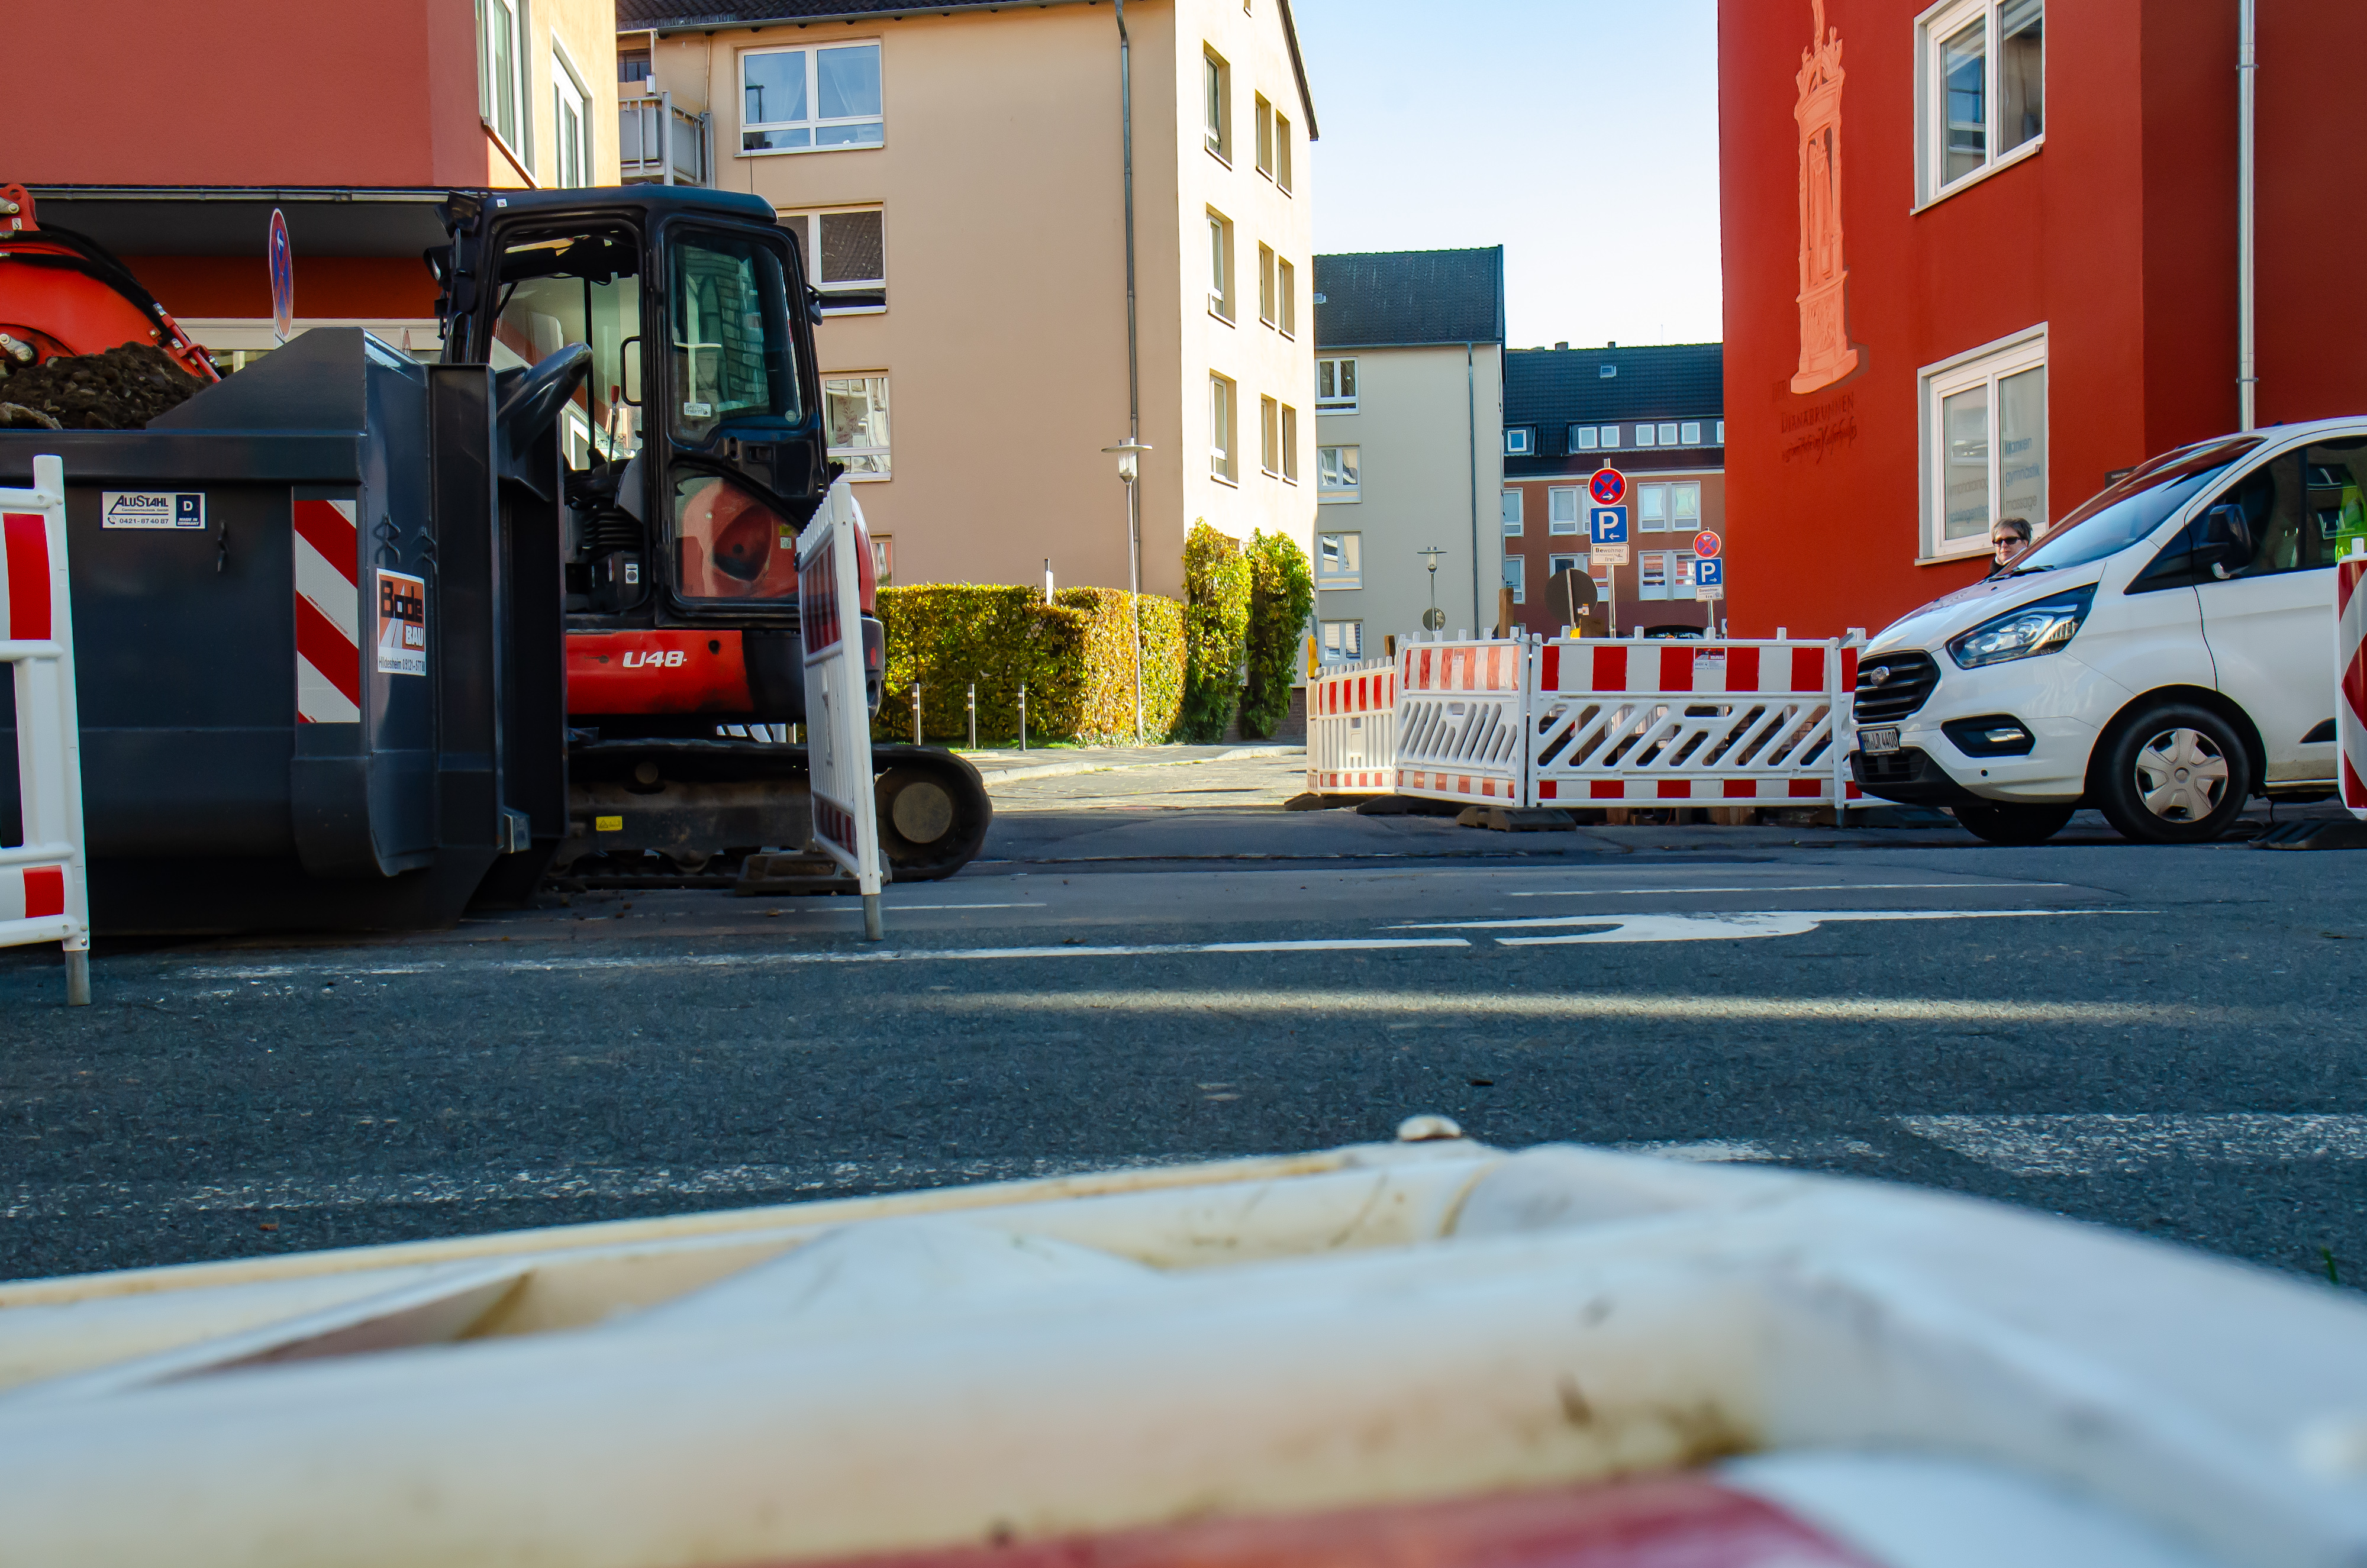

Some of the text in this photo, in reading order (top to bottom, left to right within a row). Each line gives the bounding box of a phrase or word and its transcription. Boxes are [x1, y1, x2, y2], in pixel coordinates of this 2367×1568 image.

[2005, 463, 2040, 488] gymnastik
[183, 501, 193, 511] D
[2005, 495, 2037, 512] massage
[1598, 511, 1618, 540] P
[1701, 562, 1715, 582] P
[380, 579, 423, 624] Bode
[405, 625, 424, 647] BAU
[379, 656, 402, 670] Hildesheim
[1881, 731, 1898, 748] 4408
